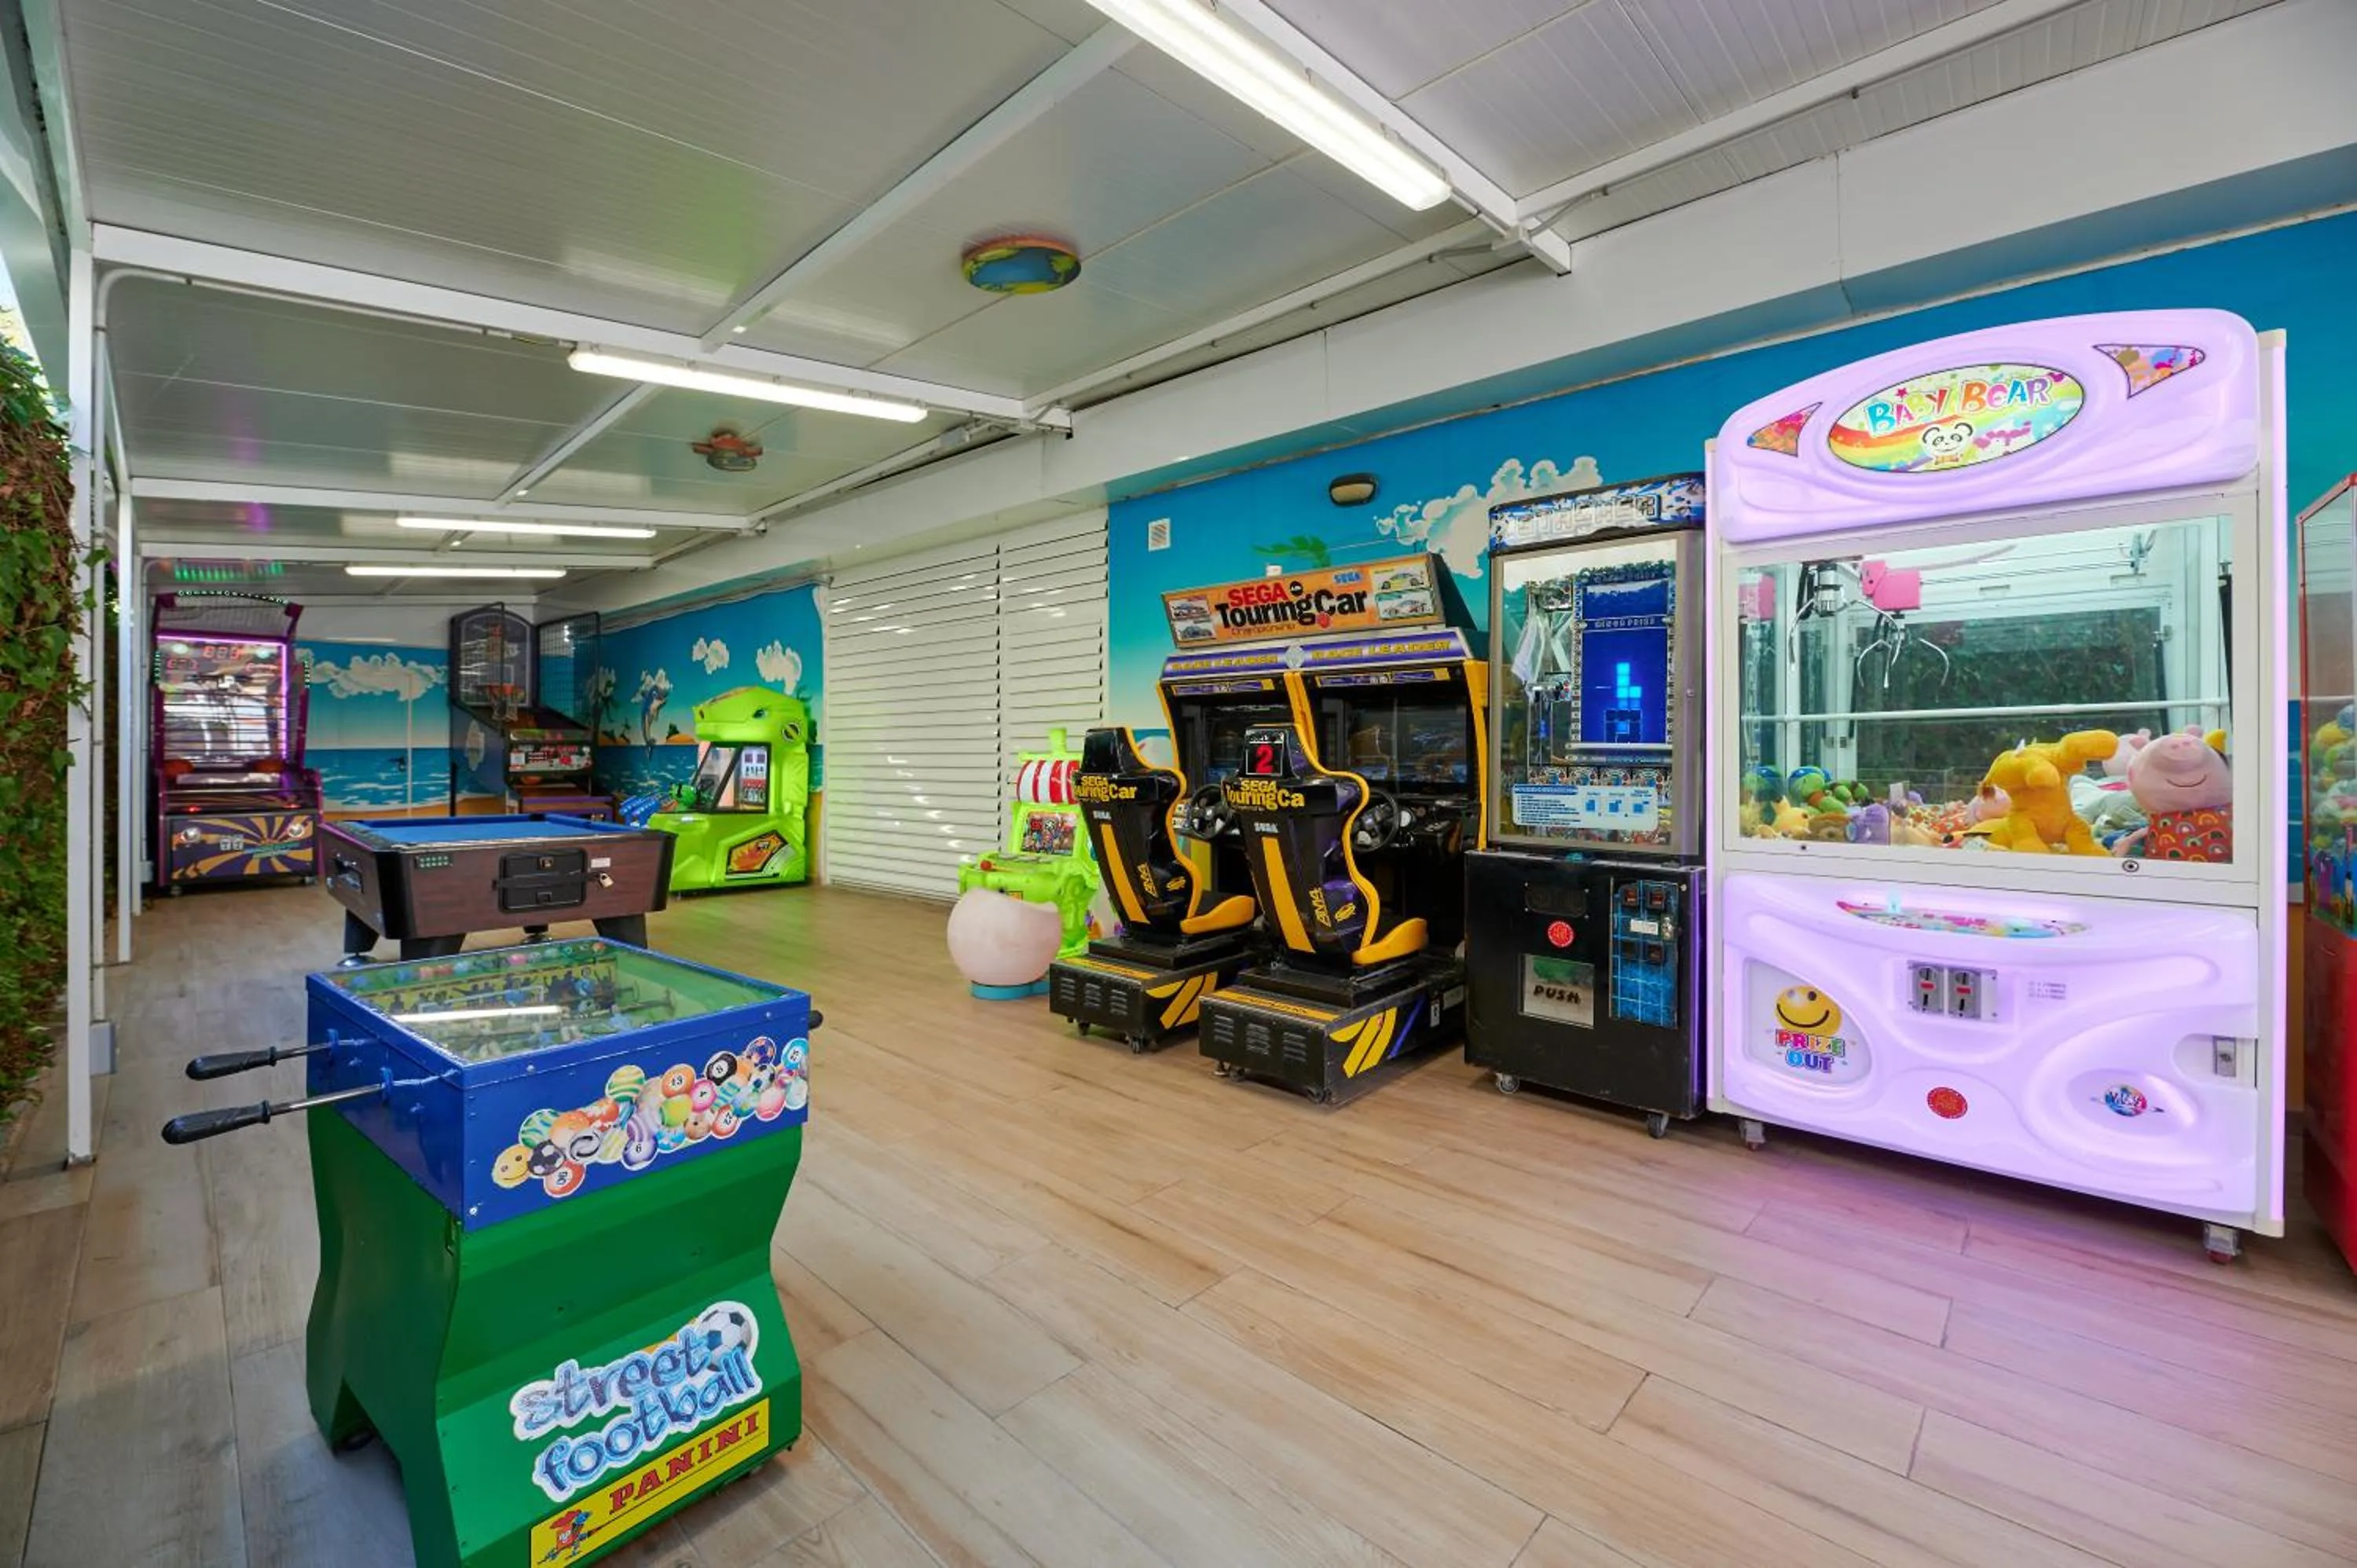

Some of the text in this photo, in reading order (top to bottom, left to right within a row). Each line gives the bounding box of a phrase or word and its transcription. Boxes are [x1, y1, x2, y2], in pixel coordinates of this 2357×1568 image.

[1865, 388, 1949, 436] BABY
[1333, 572, 1362, 584] SEGA
[1228, 582, 1289, 607] SEGA
[1256, 743, 1274, 774] 2
[1081, 775, 1109, 787] SEGA
[1241, 780, 1277, 792] SEGA
[1534, 985, 1582, 1004] PUSH
[1776, 1029, 1846, 1057] PRIZE
[1786, 1049, 1834, 1073] OUT
[515, 1326, 712, 1430] street
[541, 1346, 755, 1493] football
[608, 1410, 761, 1515] PANINI
